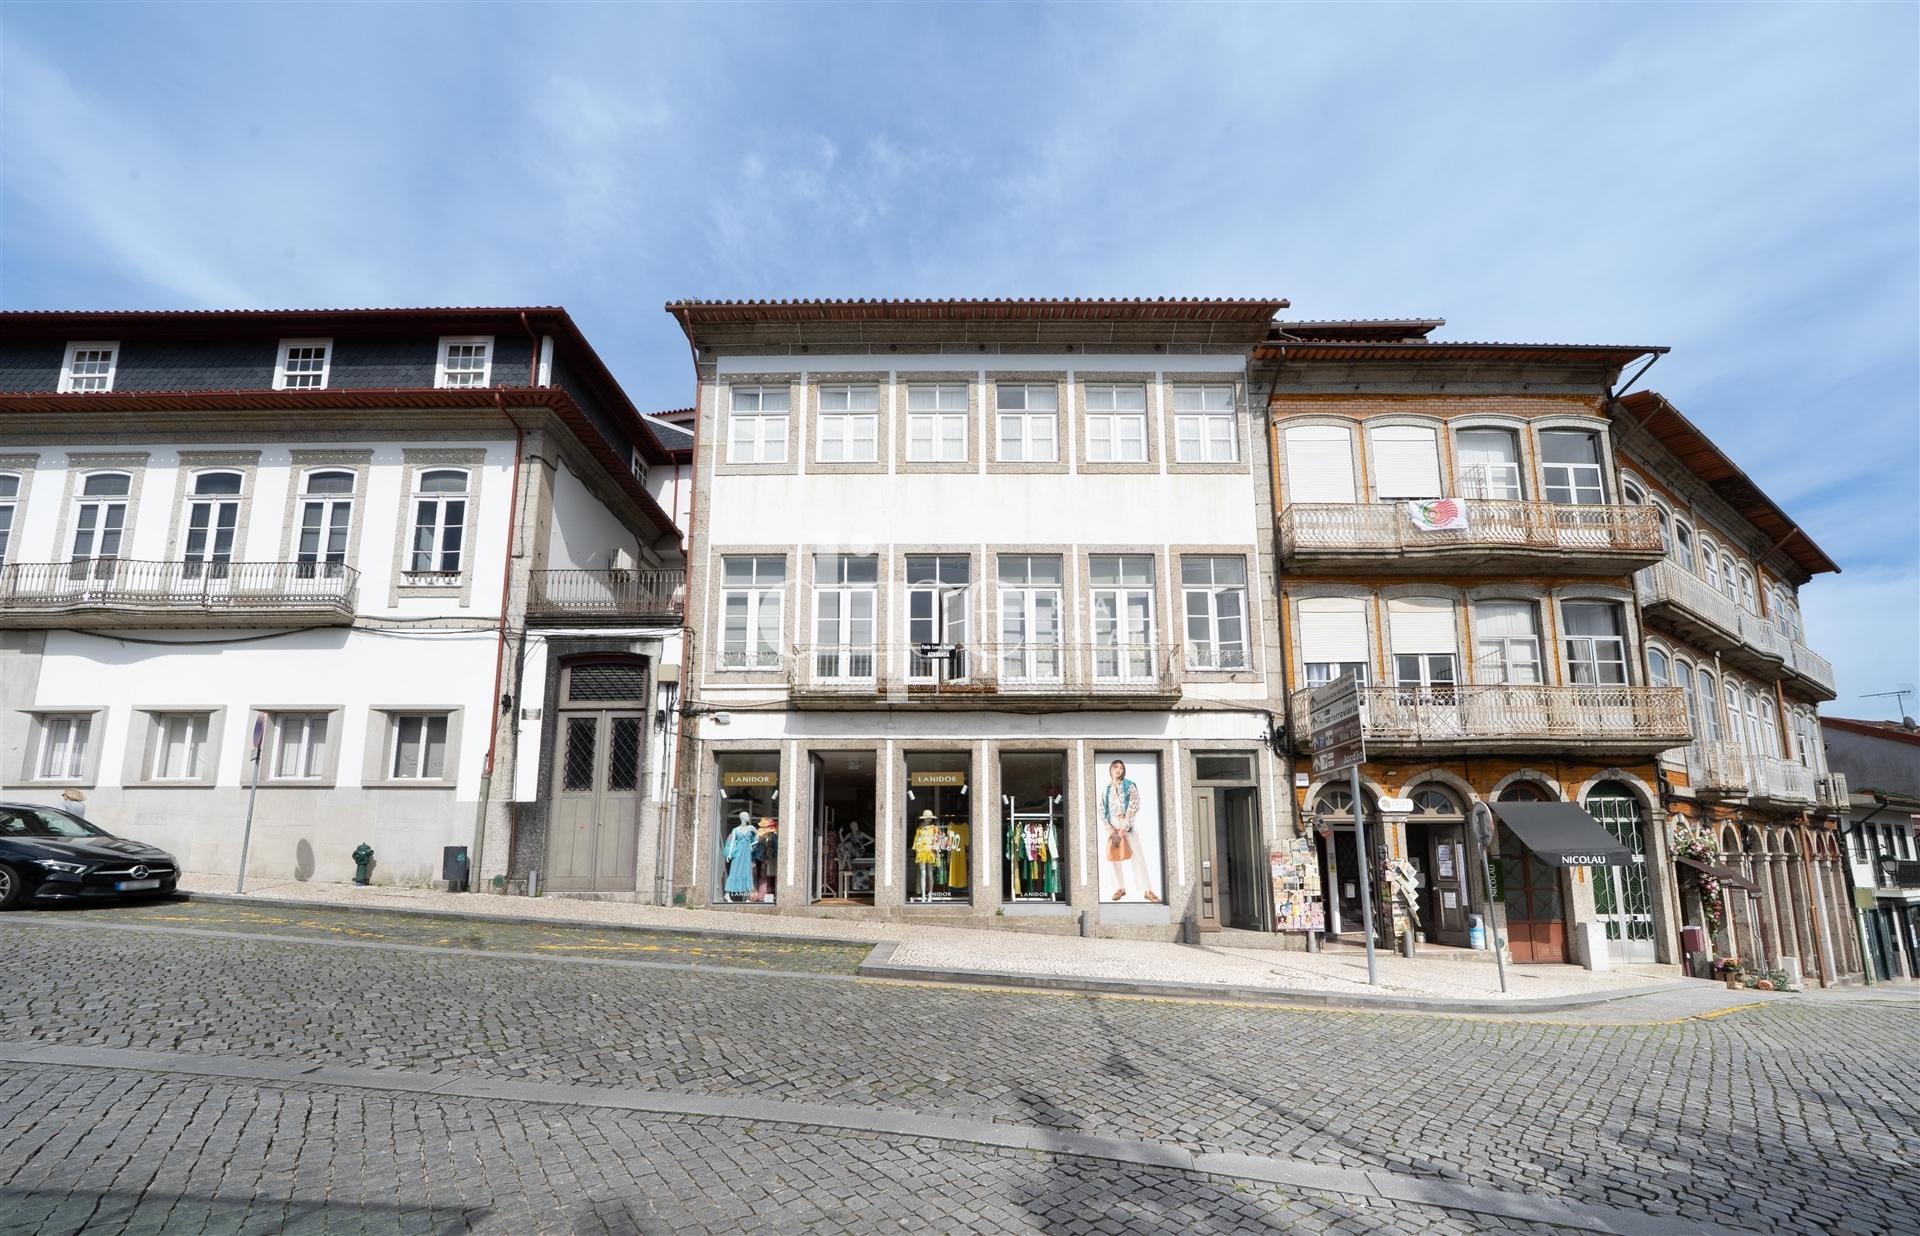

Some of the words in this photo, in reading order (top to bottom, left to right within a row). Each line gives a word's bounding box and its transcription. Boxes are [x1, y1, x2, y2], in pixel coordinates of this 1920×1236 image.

[1343, 751, 1363, 764] Jordão
[1561, 856, 1606, 864] NICOLAU
[1489, 864, 1498, 897] NICOLAU
